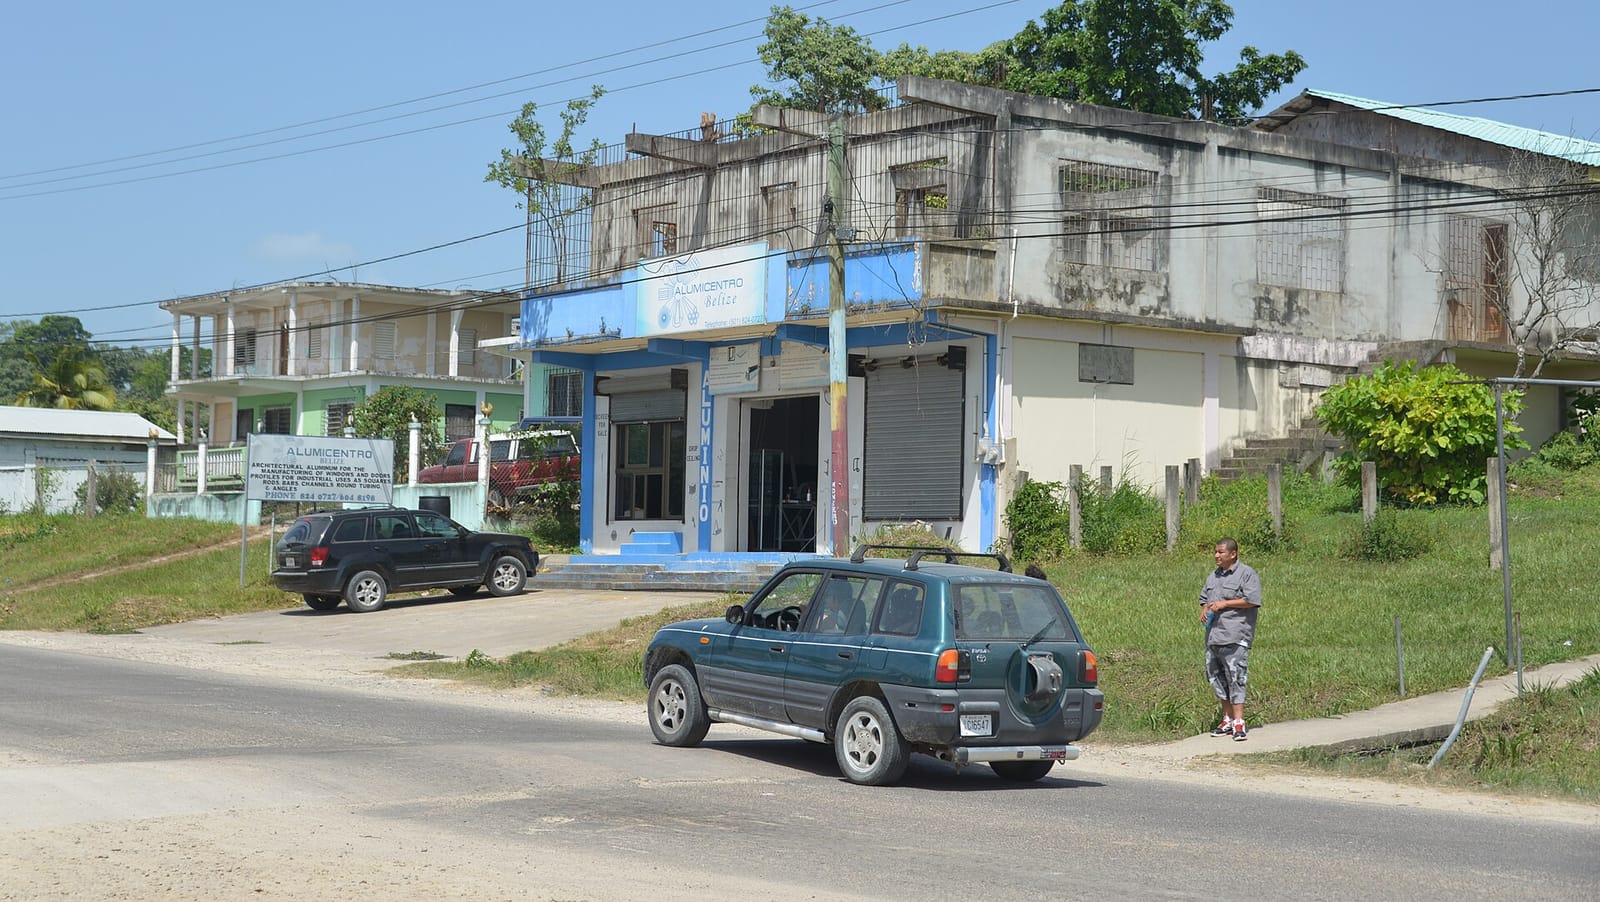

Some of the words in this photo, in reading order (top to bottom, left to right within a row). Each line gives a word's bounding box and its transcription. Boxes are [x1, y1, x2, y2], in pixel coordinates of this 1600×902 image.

[674, 278, 744, 295] ALUMICENTRO
[704, 292, 737, 308] Belize
[700, 370, 712, 522] ALUMINIO
[287, 447, 373, 459] ALUMICENTRO
[251, 462, 304, 470] ARCHITECTURAL
[320, 457, 344, 465] BELIZE
[261, 468, 314, 477] MANUFACTURING
[265, 491, 296, 500] PHONE
